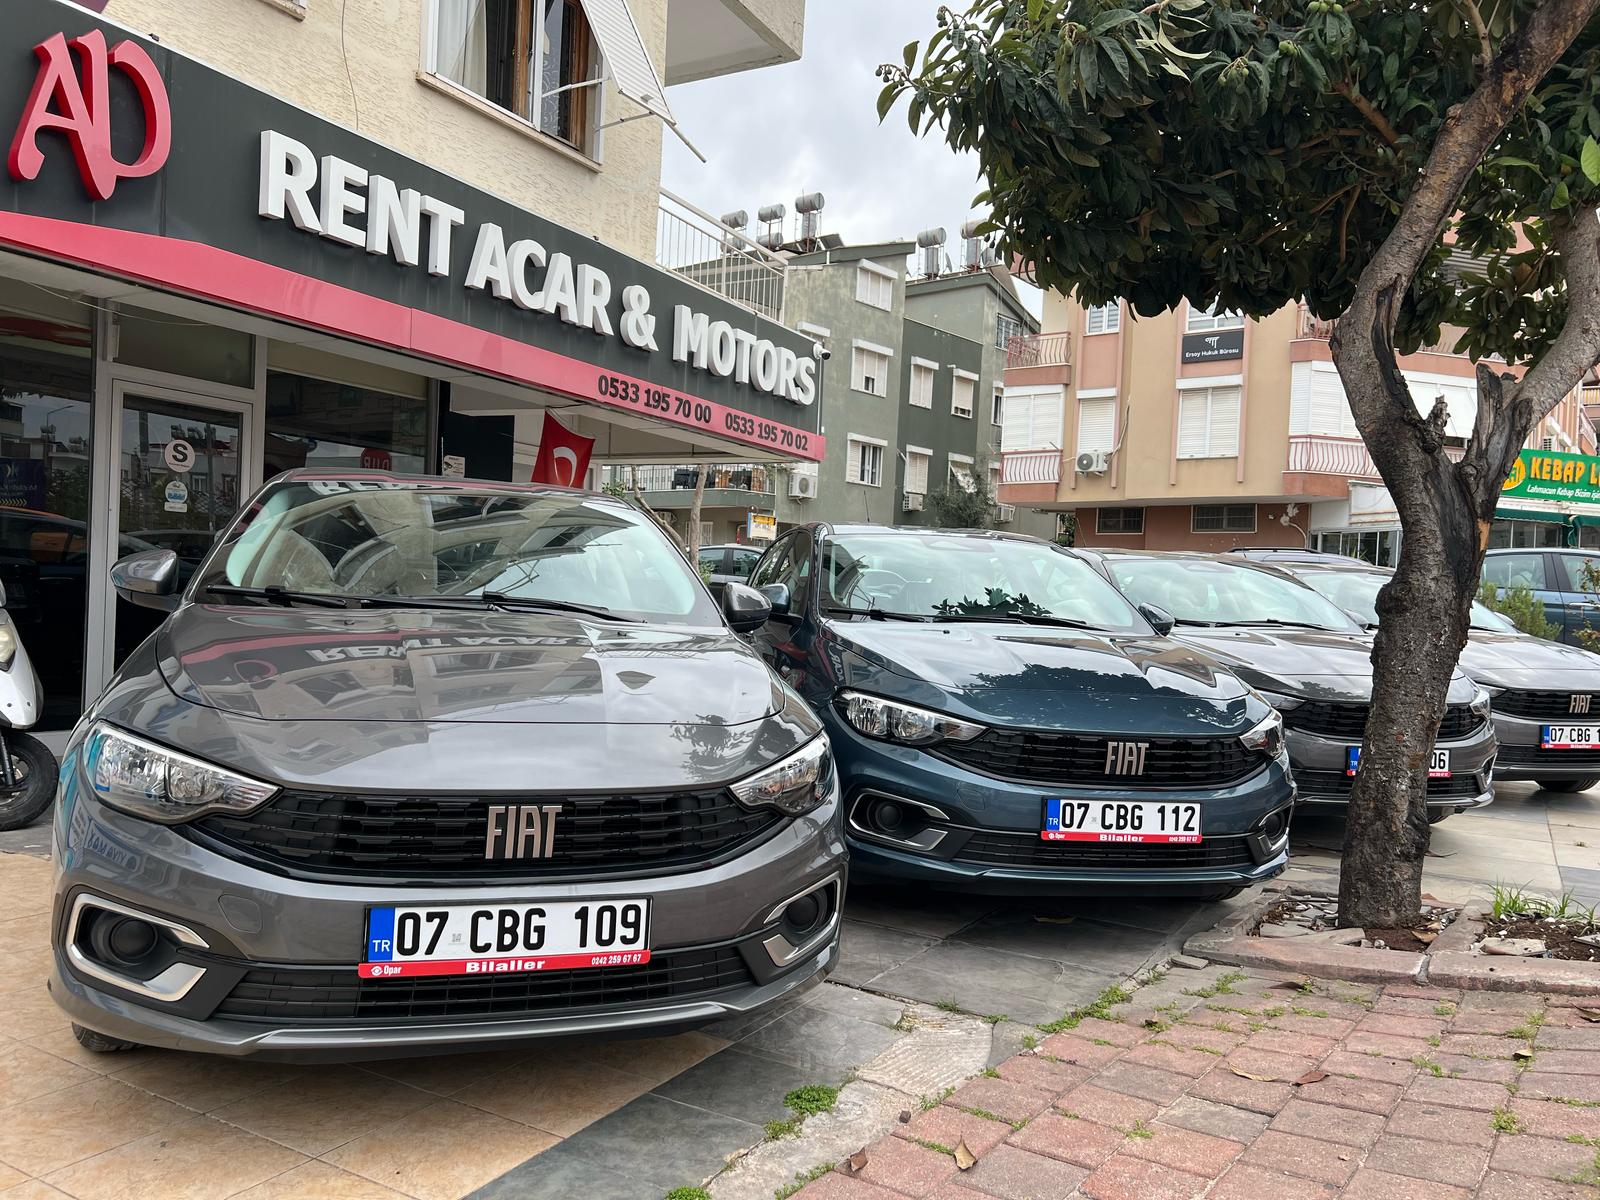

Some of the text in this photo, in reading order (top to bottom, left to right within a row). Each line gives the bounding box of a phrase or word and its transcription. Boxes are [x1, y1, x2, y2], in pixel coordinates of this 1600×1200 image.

[259, 130, 816, 406] RENT ACAR & MOTORS
[598, 375, 712, 423] 0533 195 70 00
[725, 412, 808, 451] 0533 195 70 02
[172, 443, 188, 463] S
[1530, 456, 1585, 483] KEBAP
[1526, 484, 1556, 495] Lahmacun
[1556, 487, 1574, 498] Kebap
[1574, 489, 1591, 498] Bizim
[1569, 694, 1592, 713] FIAT
[1551, 728, 1564, 742] 07
[1570, 728, 1591, 742] CBG
[1104, 741, 1149, 775] FIAT
[1048, 803, 1196, 832] TR 07 CBG 112
[485, 805, 562, 859] FIAT
[1099, 834, 1144, 842] Bilaller
[372, 904, 642, 956] TR 07 CBG 109
[384, 953, 642, 976] Opar Bilaller 0242 259 67 67
